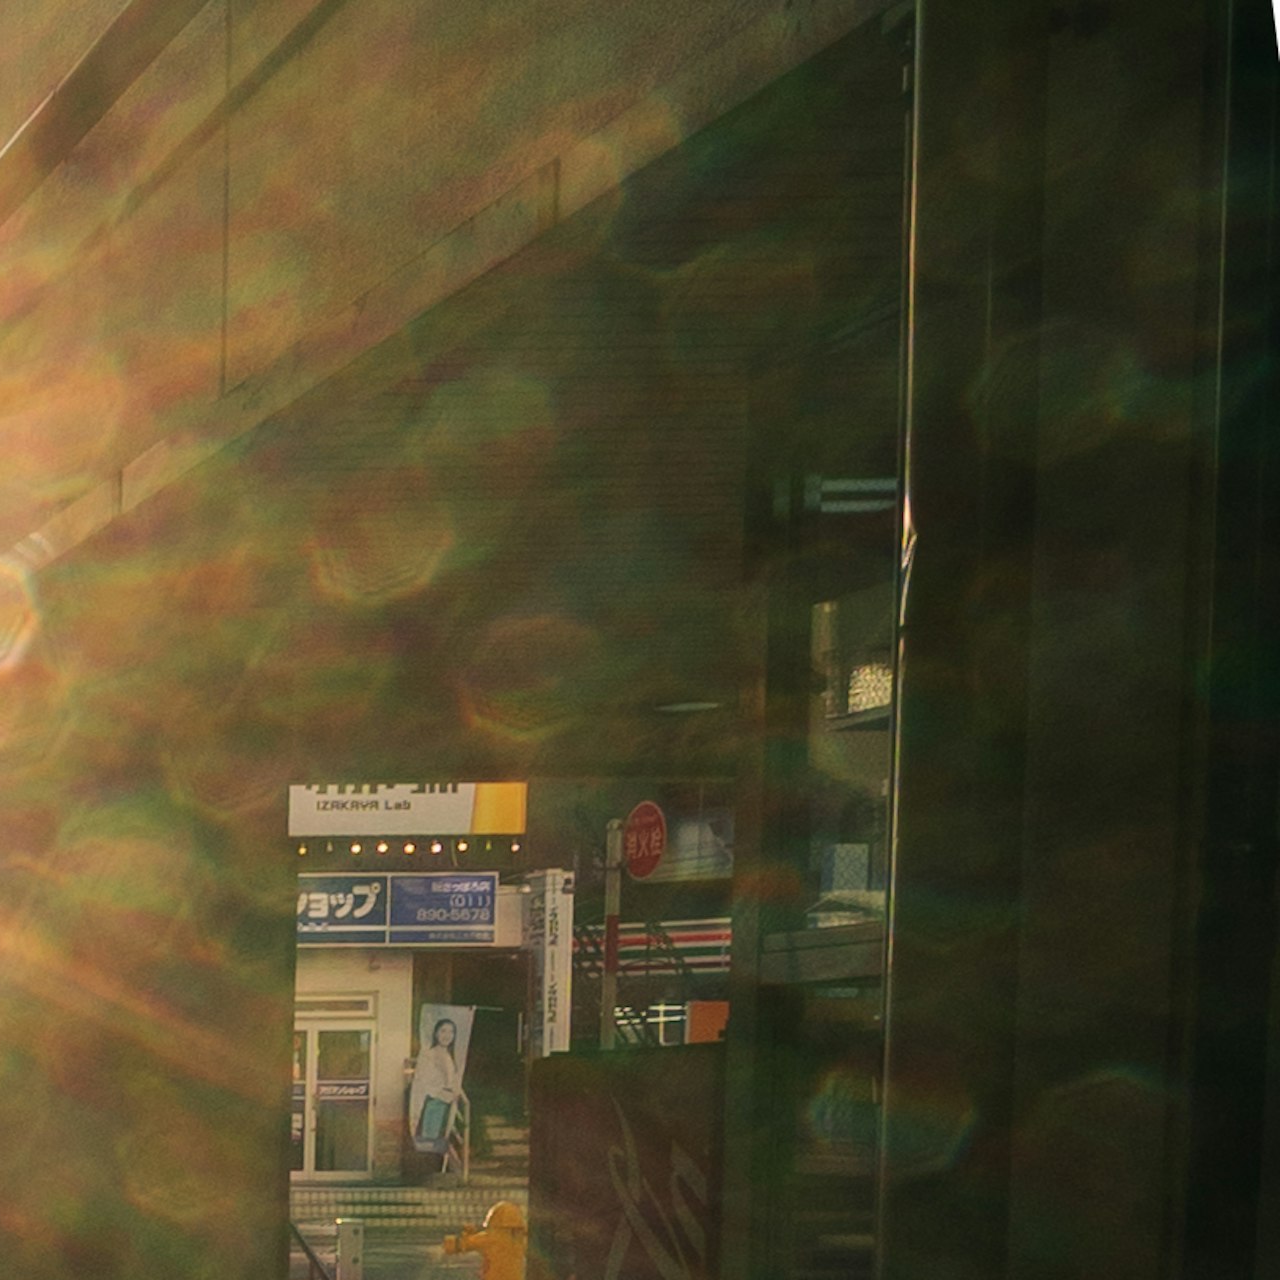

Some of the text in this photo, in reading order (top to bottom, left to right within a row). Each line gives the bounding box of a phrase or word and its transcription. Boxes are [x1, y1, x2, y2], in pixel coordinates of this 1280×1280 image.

[316, 799, 411, 811] IZAKAYA Lab
[449, 894, 491, 907] (011)
[416, 907, 490, 921] 890-5678
